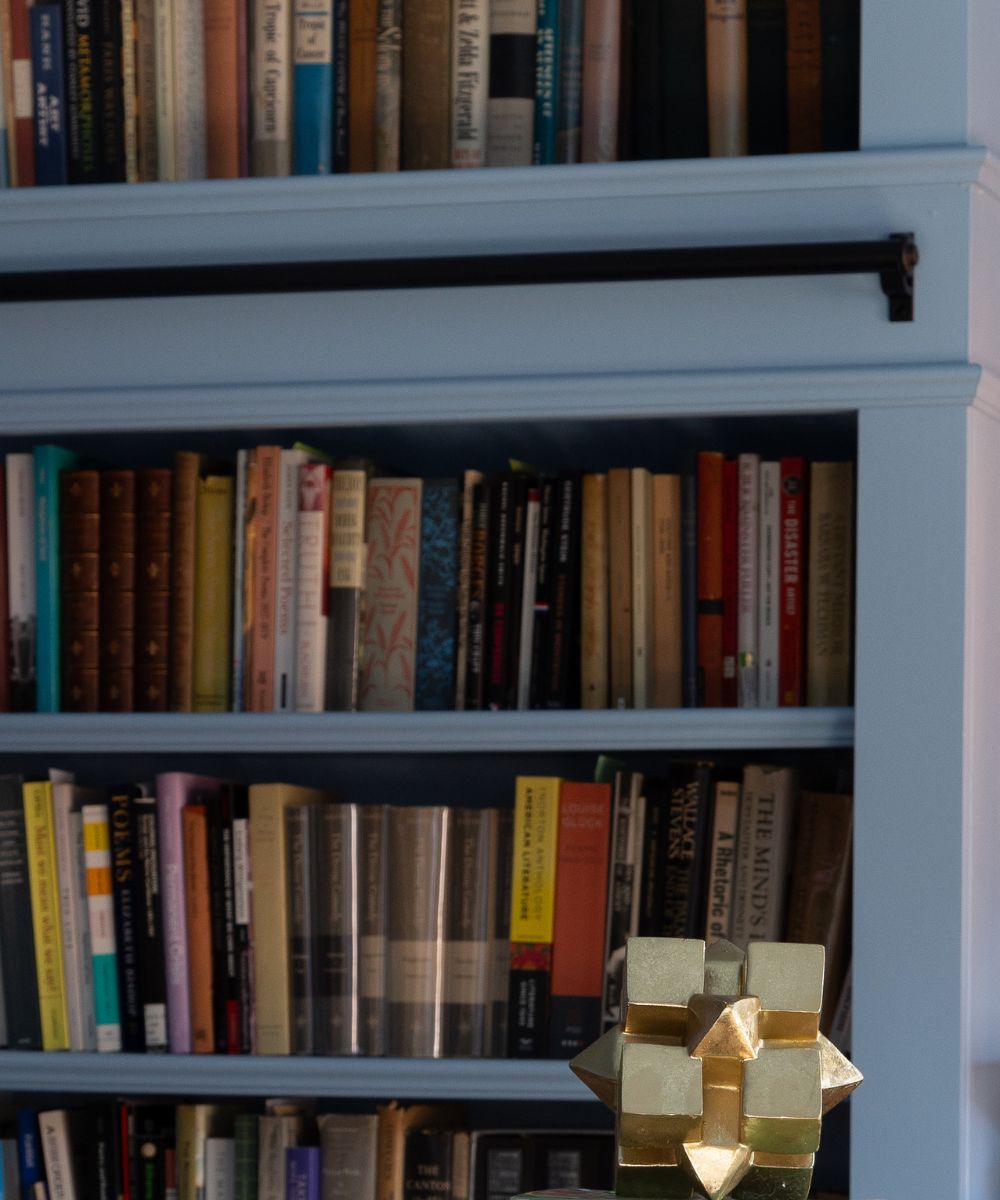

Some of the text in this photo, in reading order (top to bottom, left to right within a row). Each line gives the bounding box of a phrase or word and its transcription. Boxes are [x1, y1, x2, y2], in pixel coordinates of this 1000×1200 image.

[265, 50, 281, 63] of
[783, 518, 800, 584] DISASTER
[111, 794, 134, 883] POEMS
[520, 788, 534, 921] AMERICAN LITERATURE
[666, 787, 687, 860] STEVENS
[680, 781, 701, 860] WALLACE
[756, 792, 775, 841] THE
[710, 832, 734, 938] A Rhetoric of
[750, 846, 772, 928] MIND'S
[417, 1165, 439, 1176] THE
